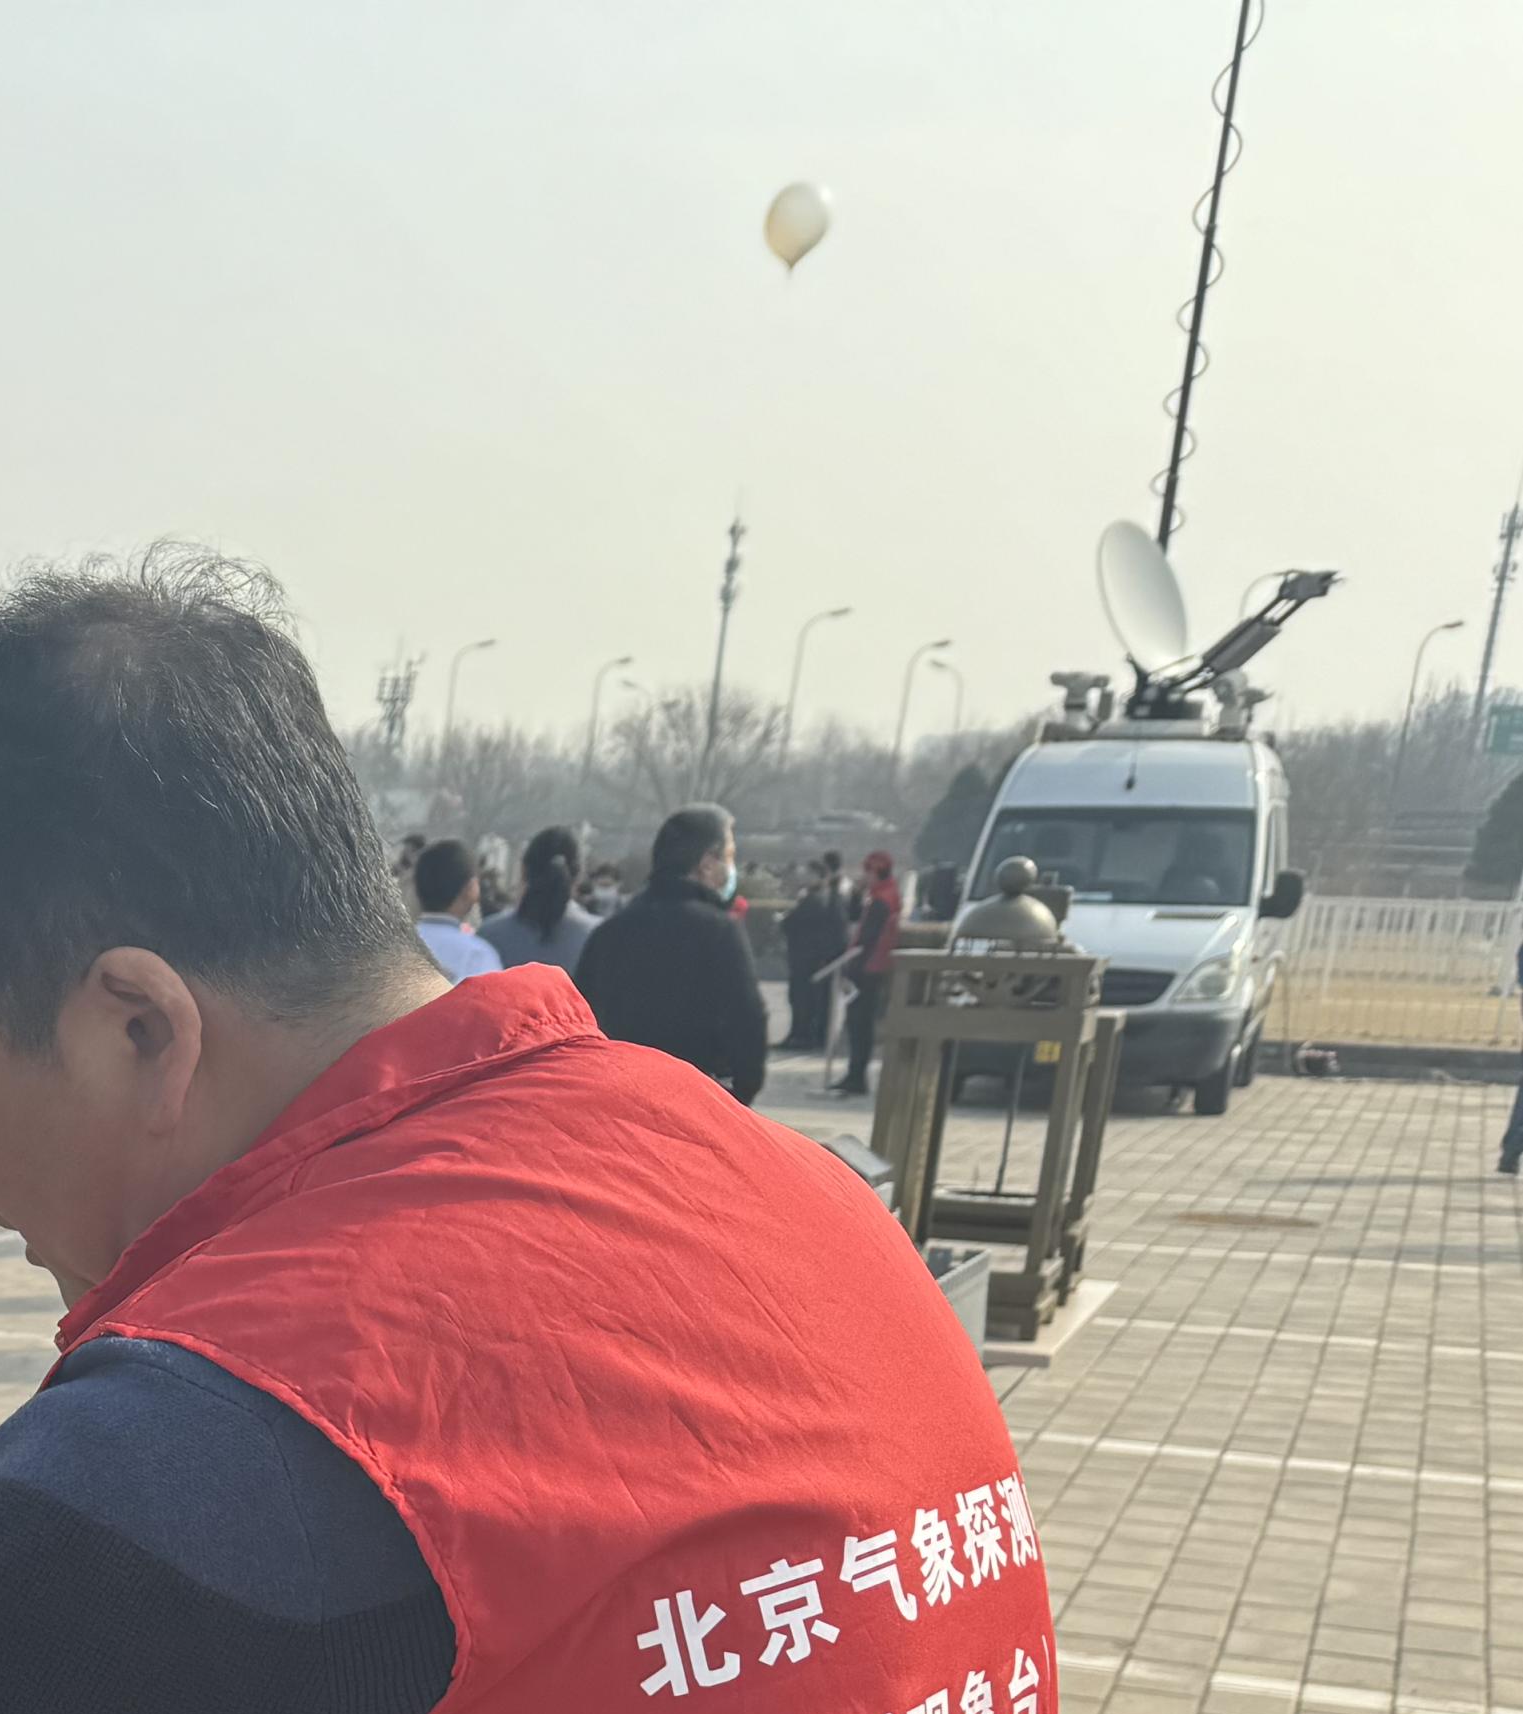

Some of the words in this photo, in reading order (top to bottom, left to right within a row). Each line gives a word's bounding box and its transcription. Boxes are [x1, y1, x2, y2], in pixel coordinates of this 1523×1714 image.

[637, 1472, 1038, 1697] 北京气象探测
